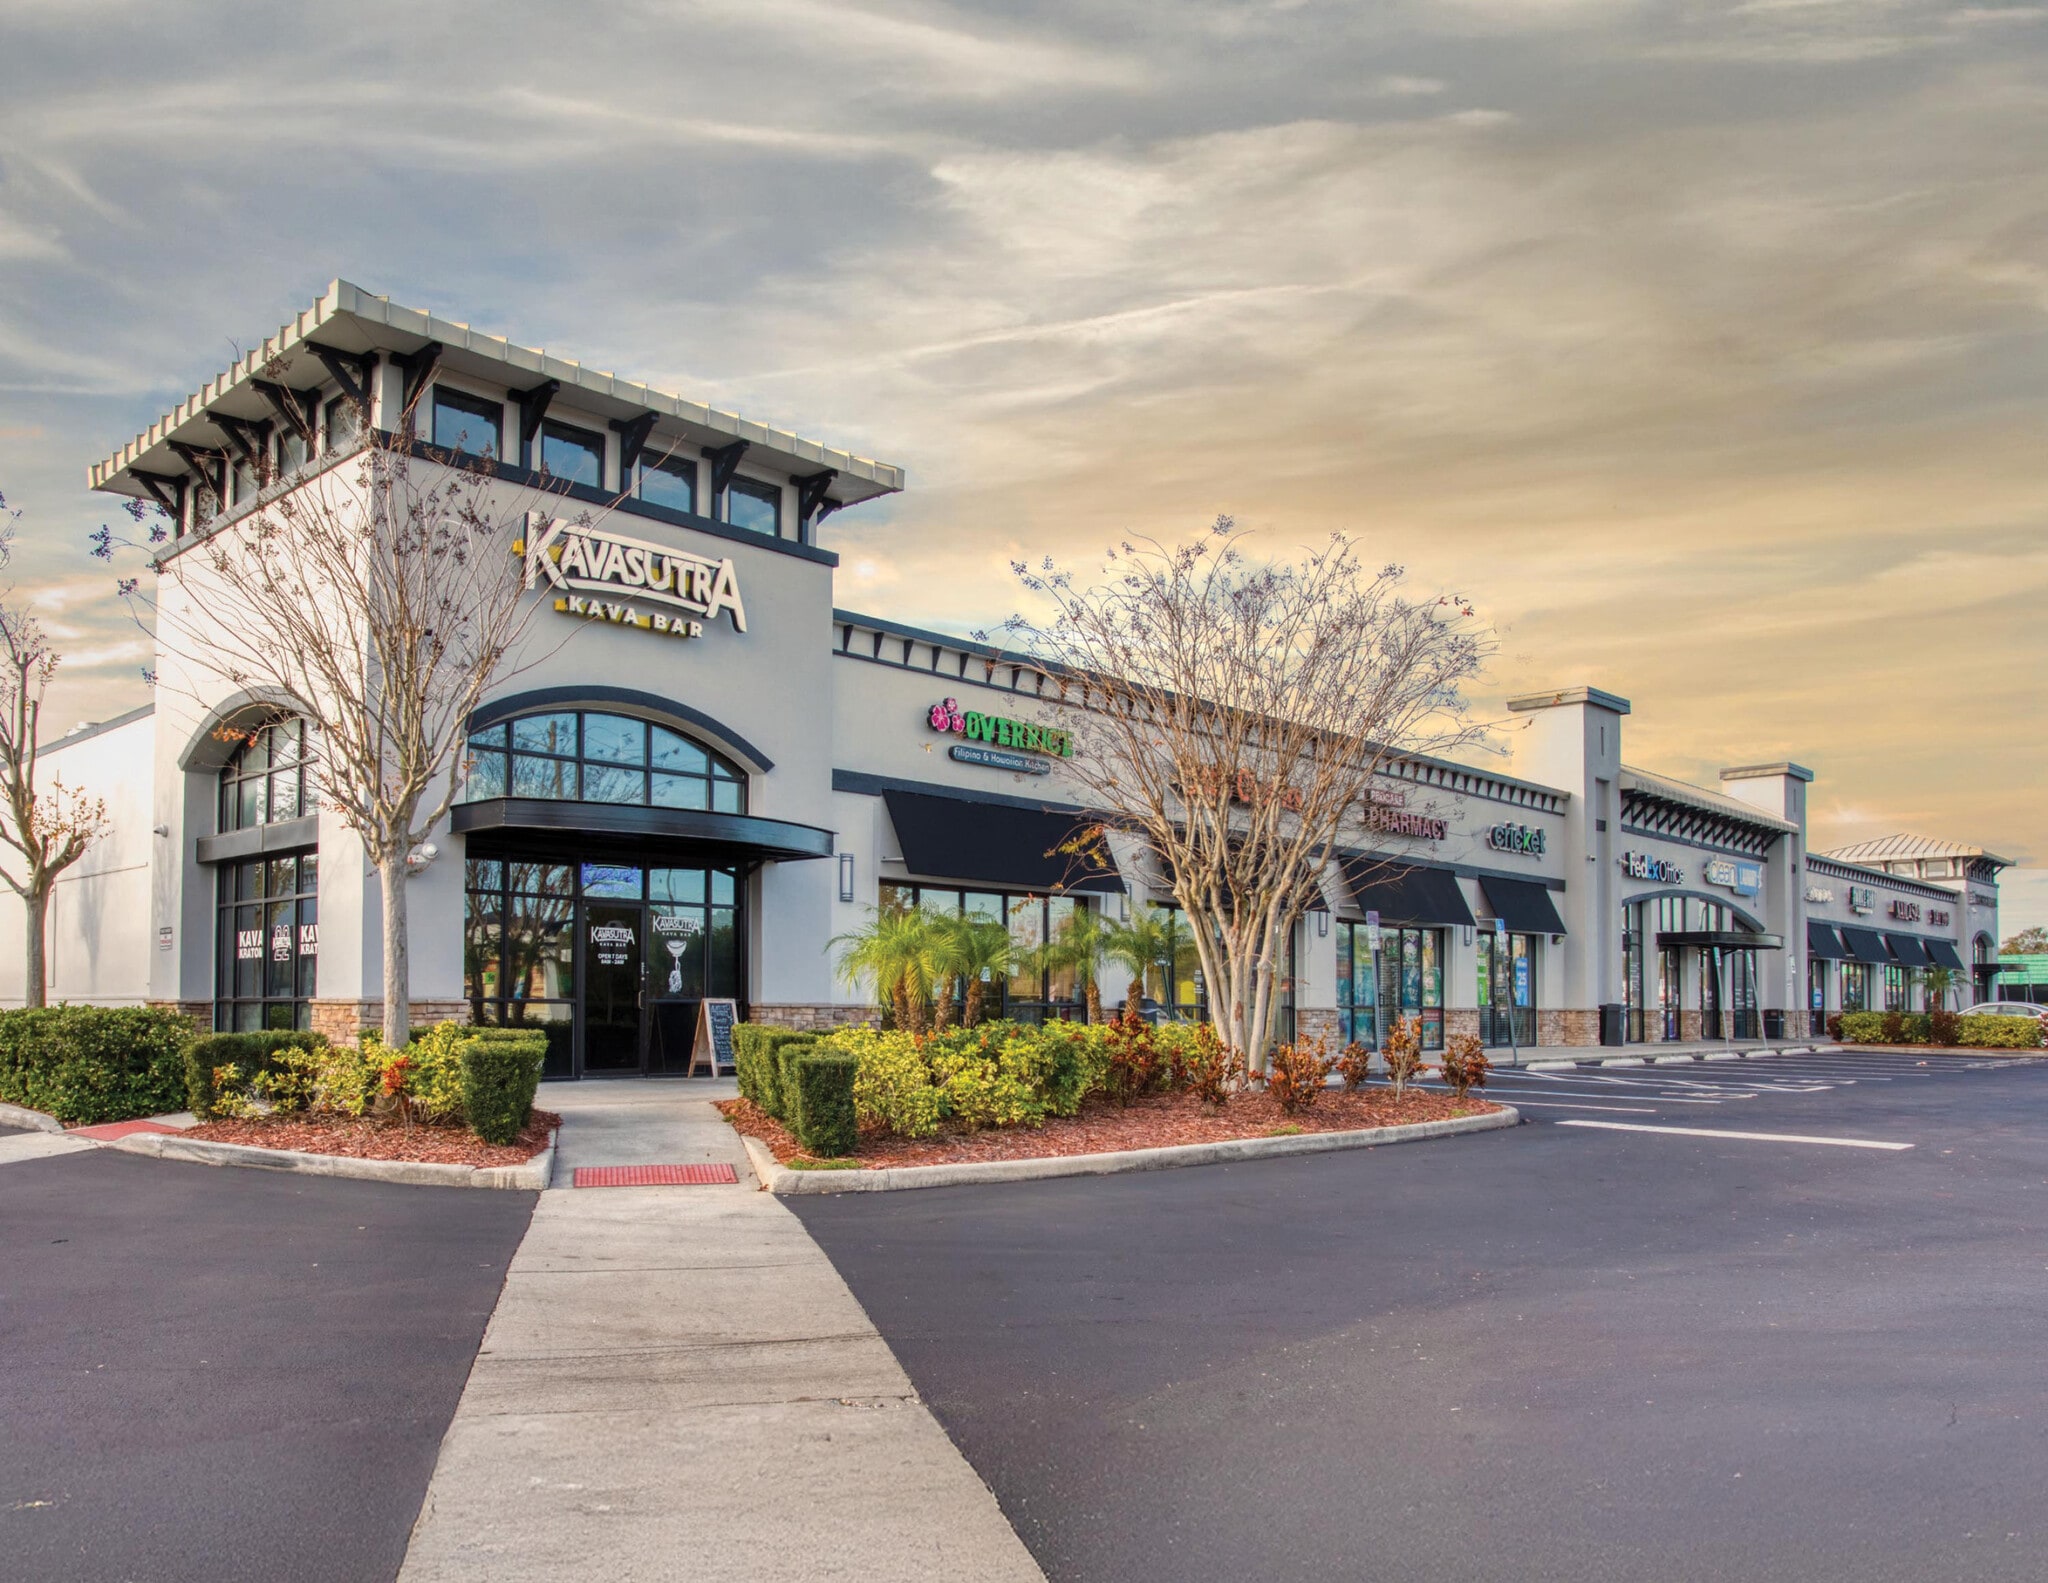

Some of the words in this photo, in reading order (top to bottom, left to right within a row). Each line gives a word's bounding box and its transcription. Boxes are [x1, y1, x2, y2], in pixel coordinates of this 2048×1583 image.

[524, 511, 747, 632] KAVASUTRA
[568, 595, 638, 623] KAVA
[652, 613, 703, 637] BAR
[953, 746, 981, 760] Filipino
[991, 754, 1023, 767] Hawaiian
[1025, 759, 1050, 771] Kitchen
[1369, 806, 1450, 840] PHARMACY
[1494, 821, 1546, 854] cricket
[1629, 851, 1659, 880] FedEx
[239, 930, 263, 947] KAVA
[591, 925, 635, 945] KAVASUTRA
[652, 915, 701, 936] KAVASUTRA
